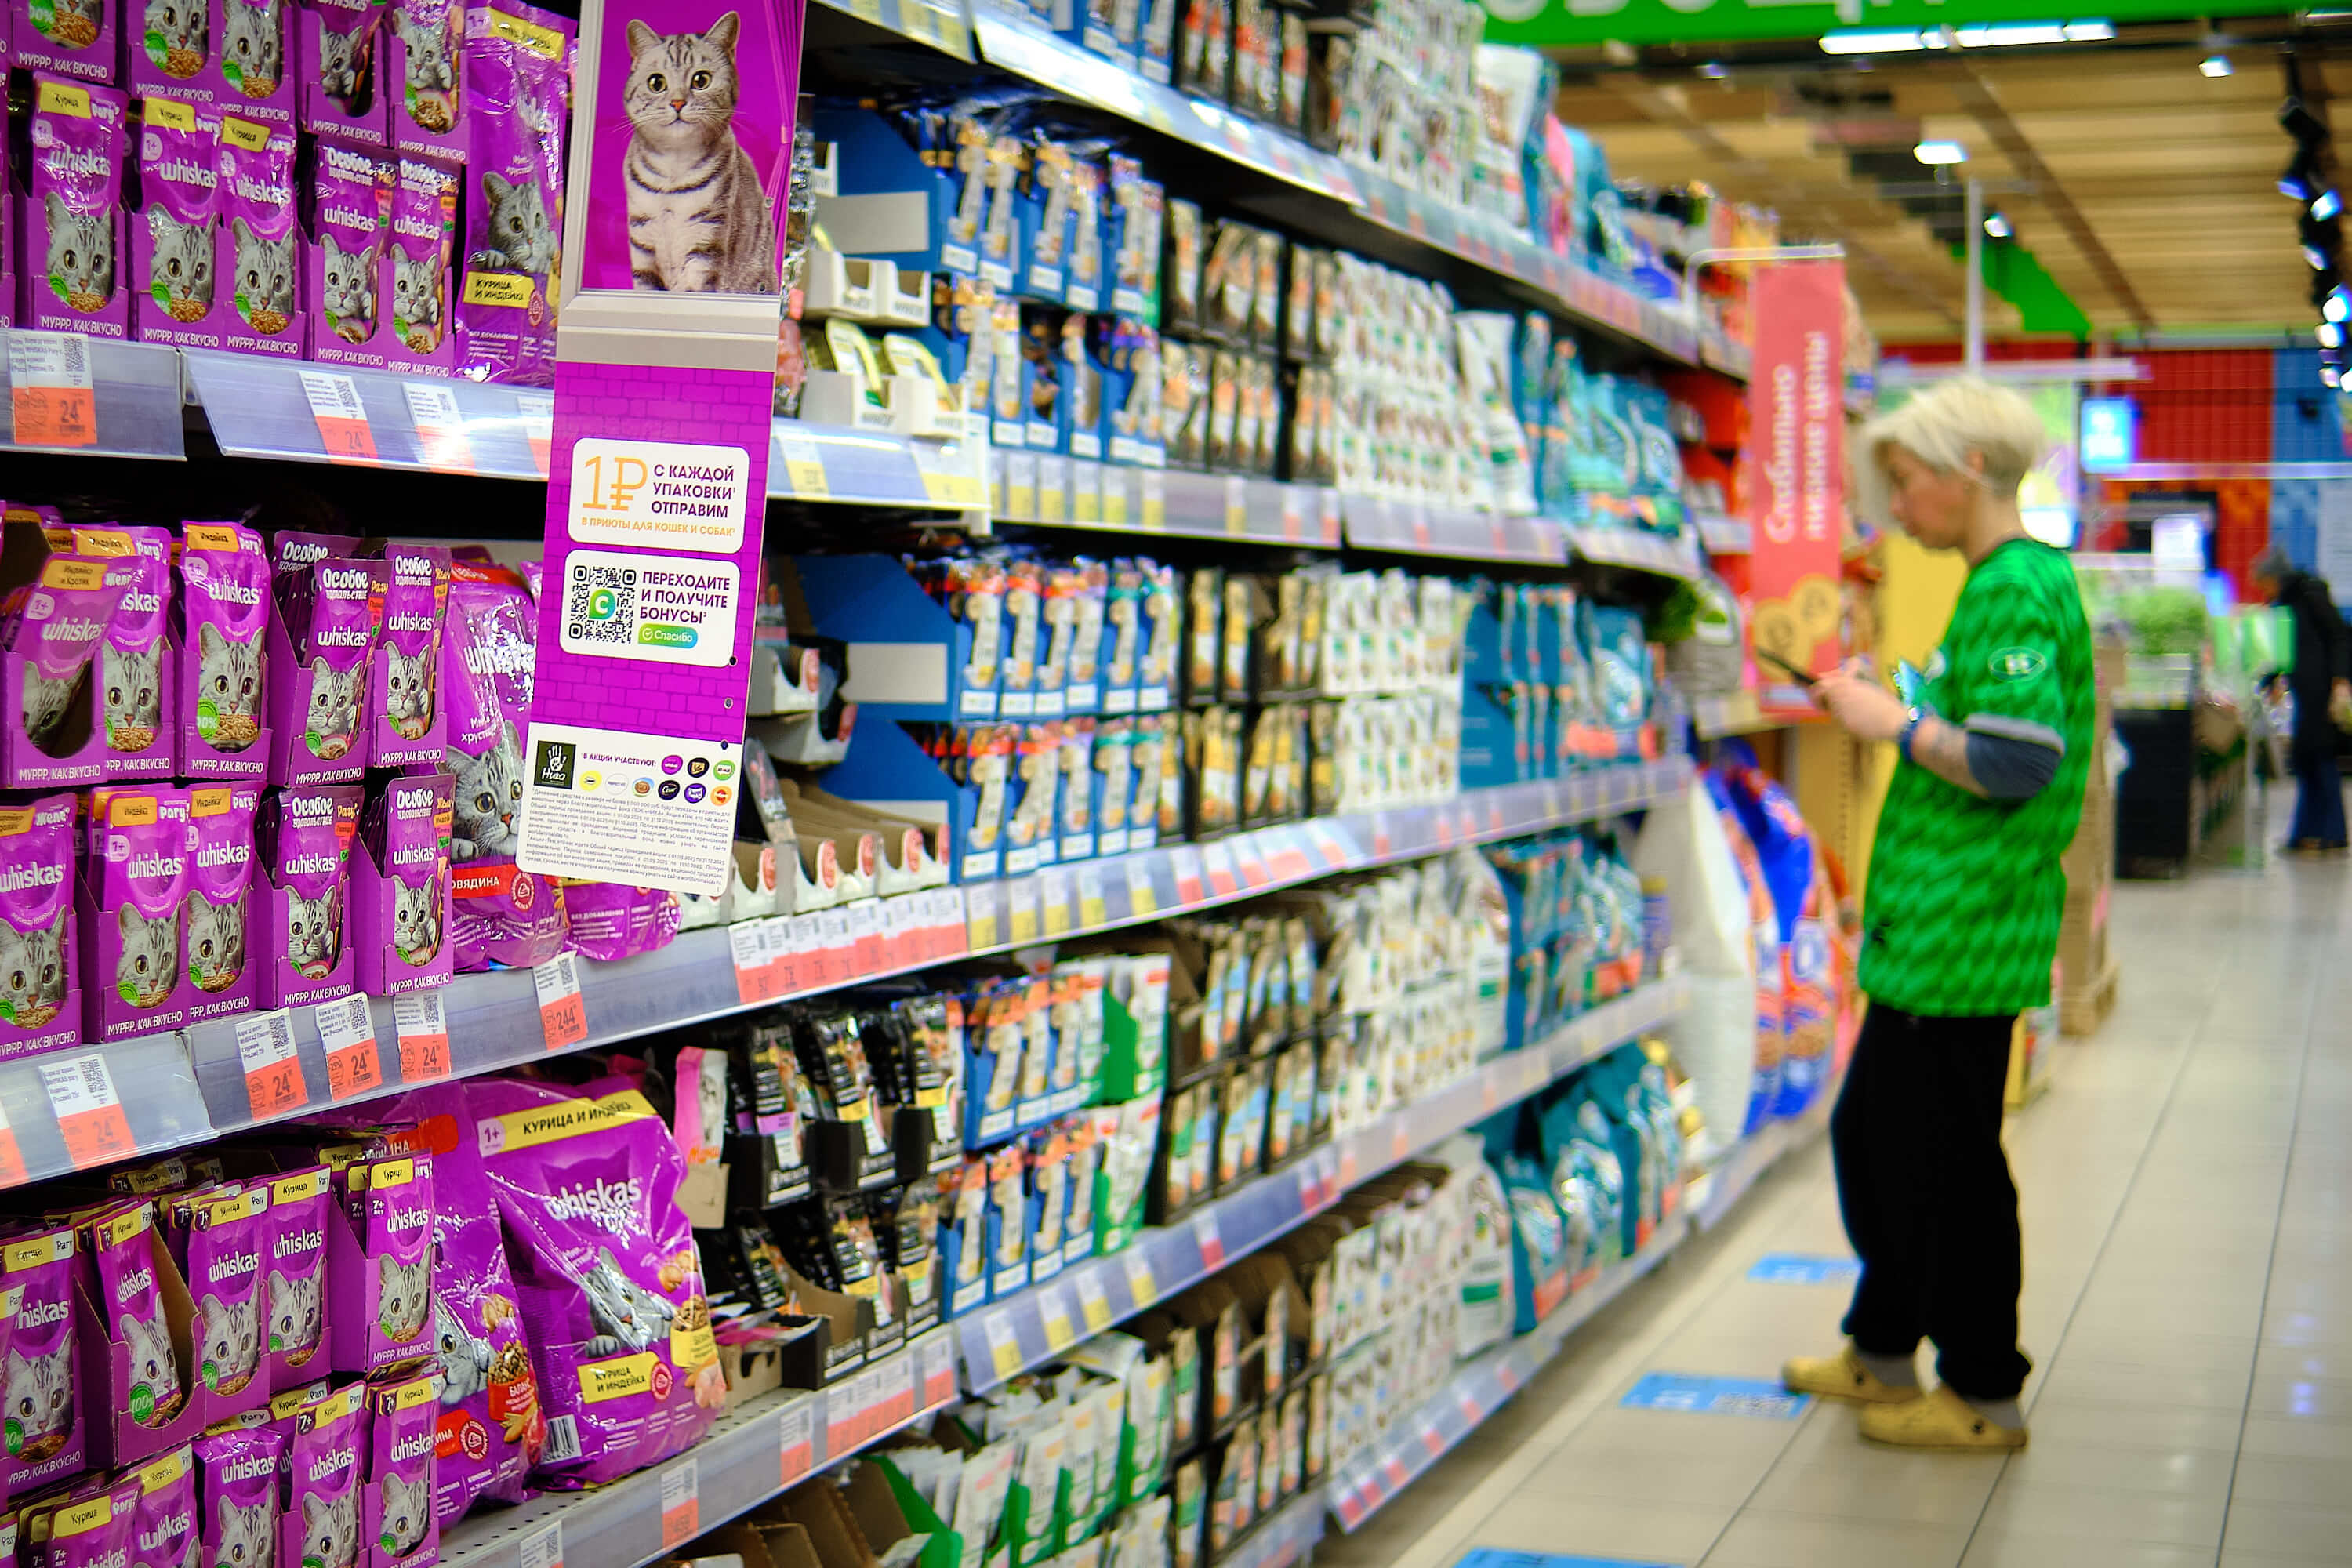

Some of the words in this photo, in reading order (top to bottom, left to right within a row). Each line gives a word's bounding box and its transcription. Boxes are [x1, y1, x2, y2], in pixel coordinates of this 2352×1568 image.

[54, 58, 72, 74] КАК
[73, 60, 108, 79] ВКУСНО
[160, 158, 218, 189] whiskas
[324, 204, 376, 233] whiskas
[394, 215, 440, 241] whiskas
[74, 319, 91, 335] КАК
[91, 321, 122, 337] ВКУСНО
[173, 331, 191, 346] КАК
[191, 333, 219, 347] ВКУСНО
[256, 339, 270, 353] КАК
[269, 341, 299, 354] ВКУСНО
[654, 464, 665, 477] С
[669, 464, 735, 482] КАЖДОЙ
[652, 500, 728, 518] ОТПРАВИМ
[582, 517, 588, 526] В
[590, 517, 630, 530] ПРИЮТЫ
[633, 521, 652, 532] ДЛЯ
[655, 523, 688, 535] КОШЕК
[395, 555, 433, 576] Особое
[322, 568, 368, 589] Особое
[643, 572, 731, 591] ПЕРЕХОДИТЕ
[209, 579, 260, 605] whiskas
[641, 589, 651, 601] И
[655, 590, 728, 608] ПОЛУЧИТЕ
[42, 616, 107, 642] whiskas
[389, 611, 434, 632] whiskas
[318, 626, 368, 648] whiskas
[655, 630, 693, 644] Спасибо
[107, 760, 123, 771] РРР,
[124, 759, 140, 771] КАК
[141, 757, 170, 771] ВКУСНО
[404, 750, 417, 763] КАК
[417, 748, 441, 761] ВКУСНО
[589, 753, 613, 763] АКЦИИ
[614, 755, 657, 768] УЧАСТВУЮТ:
[52, 766, 67, 780] КАК
[69, 764, 101, 779] ВКУСНО
[220, 760, 236, 772] КАК
[235, 761, 263, 774] ВКУСНО
[321, 769, 336, 782] КАК
[336, 766, 361, 780] ВКУСНО
[292, 796, 334, 817] Особое
[397, 789, 434, 808] Особое
[197, 840, 250, 868] whiskas
[285, 851, 338, 875] whiskas
[394, 843, 436, 866] whiskas
[127, 852, 183, 880] whiskas
[0, 862, 64, 892] whiskas
[452, 876, 499, 891] ОВЯДИНА
[414, 978, 426, 991] КАК
[426, 972, 450, 987] ВКУСНО
[285, 993, 310, 1006] МУРРР,
[310, 989, 325, 1002] КАК
[325, 985, 350, 1000] ВКУСНО
[190, 1007, 205, 1019] РРР,
[206, 1003, 221, 1016] КАК
[221, 996, 249, 1013] ВКУСНО
[137, 1018, 153, 1032] КАК
[154, 1011, 183, 1029] ВКУСНО
[26, 1038, 43, 1051] КАК
[44, 1031, 76, 1049] ВКУСНО
[350, 1051, 367, 1076] 24
[422, 1046, 437, 1067] 24
[273, 1072, 291, 1098] 24
[523, 1113, 574, 1135] КУРИЦА
[577, 1110, 586, 1123] И
[372, 1200, 385, 1209] 7+
[545, 1178, 642, 1221] whiskas
[387, 1206, 430, 1233] whiskas
[274, 1228, 323, 1259] whiskas
[209, 1251, 260, 1283] whiskas
[117, 1265, 153, 1302] whiskas
[16, 1298, 71, 1330] hiskas
[606, 1376, 647, 1391] ИНДЕЙКА
[299, 1415, 312, 1429] 7+
[8, 1471, 32, 1487] УРРР,
[32, 1461, 49, 1478] КАК
[49, 1450, 82, 1472] ВКУСНО
[221, 1454, 276, 1485] whiskas
[309, 1445, 356, 1483] whiskas
[71, 1509, 98, 1525] Курица
[140, 1510, 191, 1552] whiskas
[55, 1548, 67, 1561] 7+
